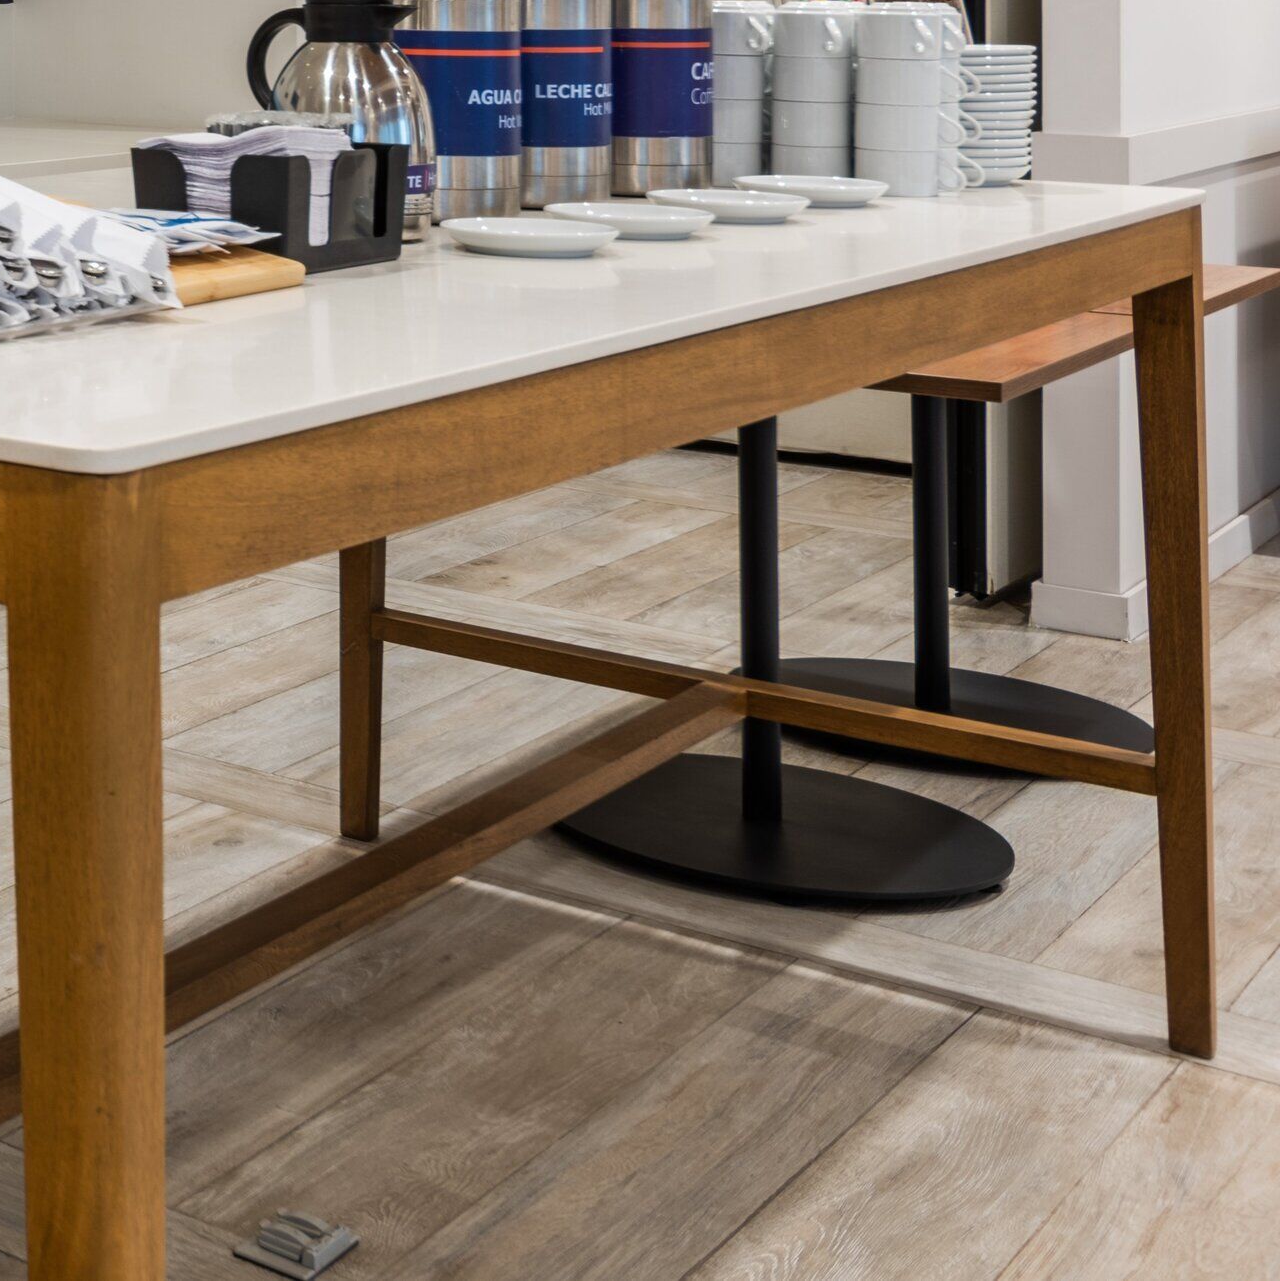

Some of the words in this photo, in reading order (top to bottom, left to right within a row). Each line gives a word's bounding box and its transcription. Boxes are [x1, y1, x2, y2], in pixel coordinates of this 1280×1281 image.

[467, 89, 512, 105] AGUA
[535, 84, 592, 99] LECHE
[583, 103, 603, 116] Hot
[498, 115, 516, 129] Hot
[406, 175, 422, 188] TE
